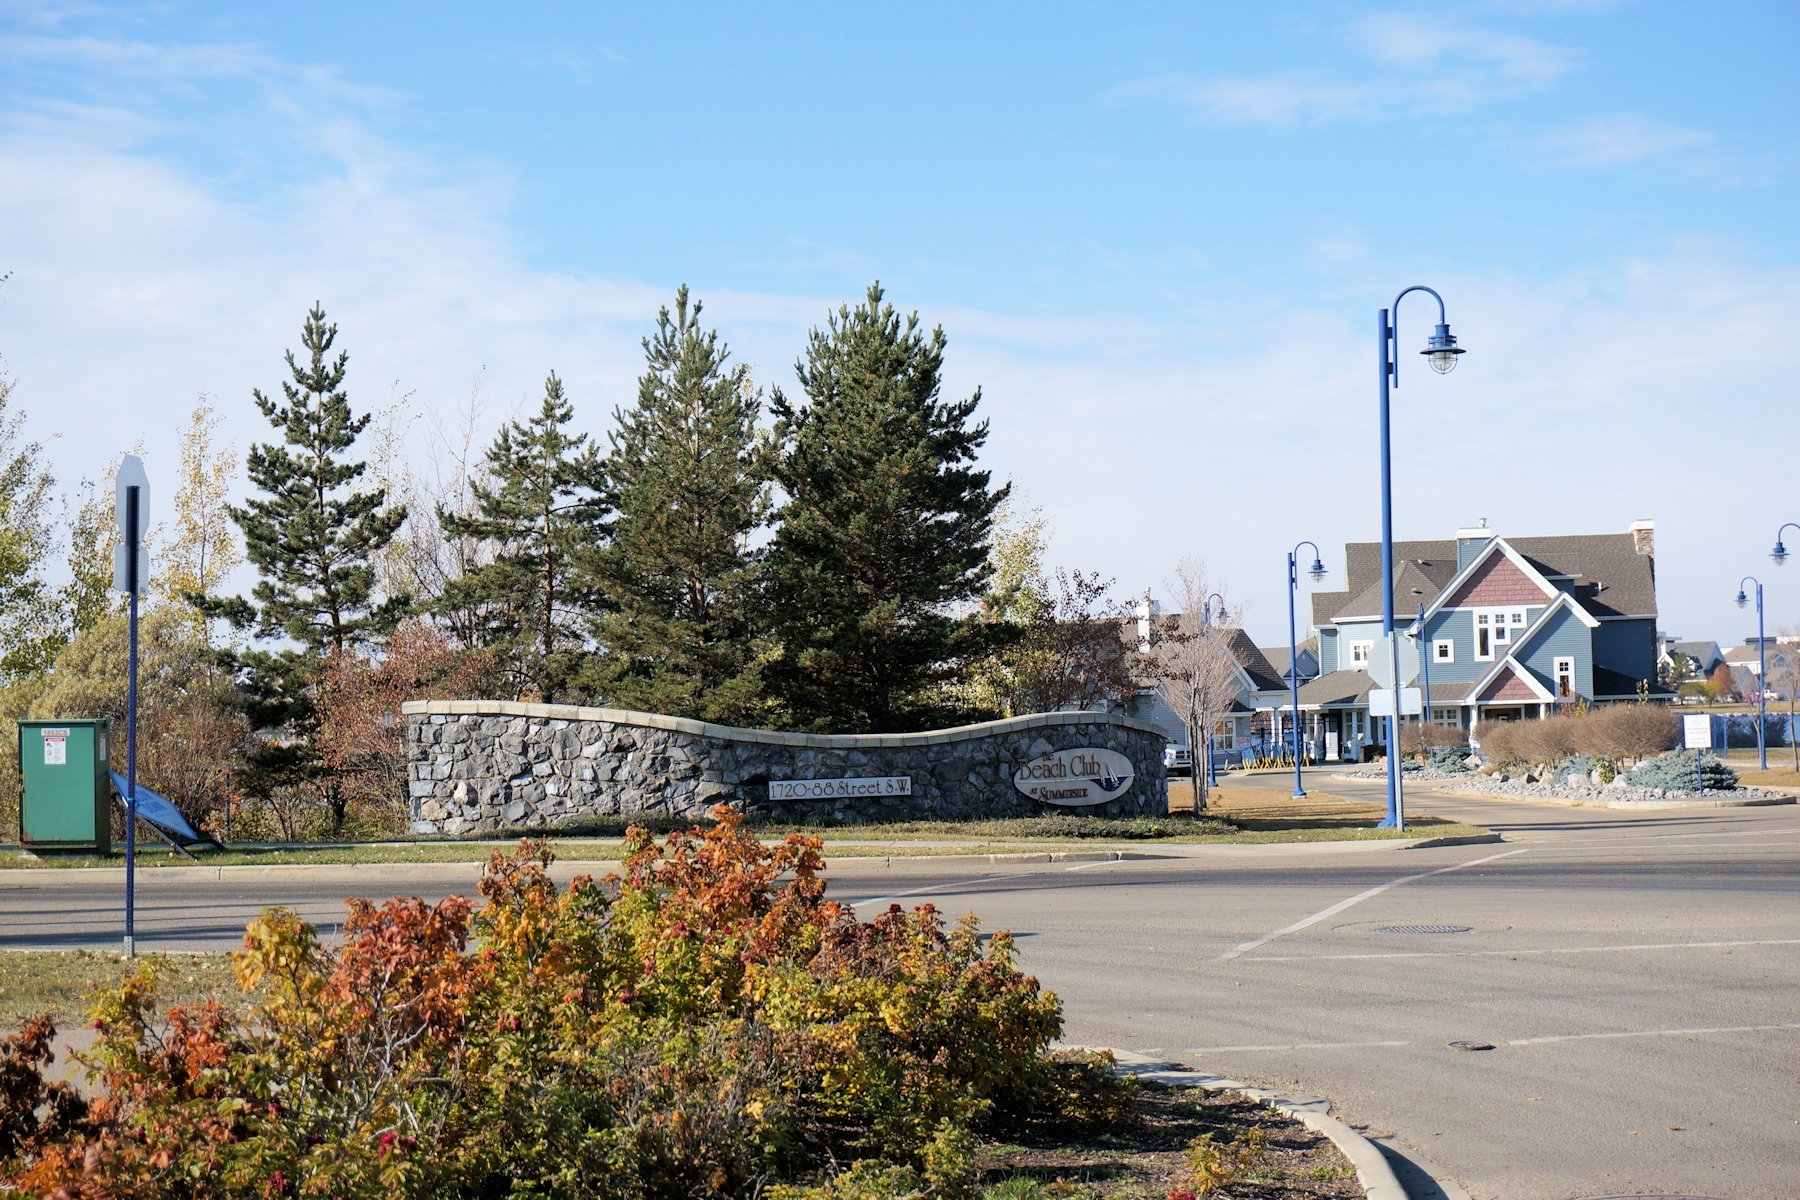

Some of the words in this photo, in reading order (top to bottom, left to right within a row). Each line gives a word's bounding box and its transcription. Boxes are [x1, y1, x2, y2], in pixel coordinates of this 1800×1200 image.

[1018, 756, 1067, 780] Beach
[1070, 755, 1101, 777] Club
[770, 782, 834, 798] 1720-88
[837, 780, 882, 795] Street
[886, 778, 910, 793] S.W.
